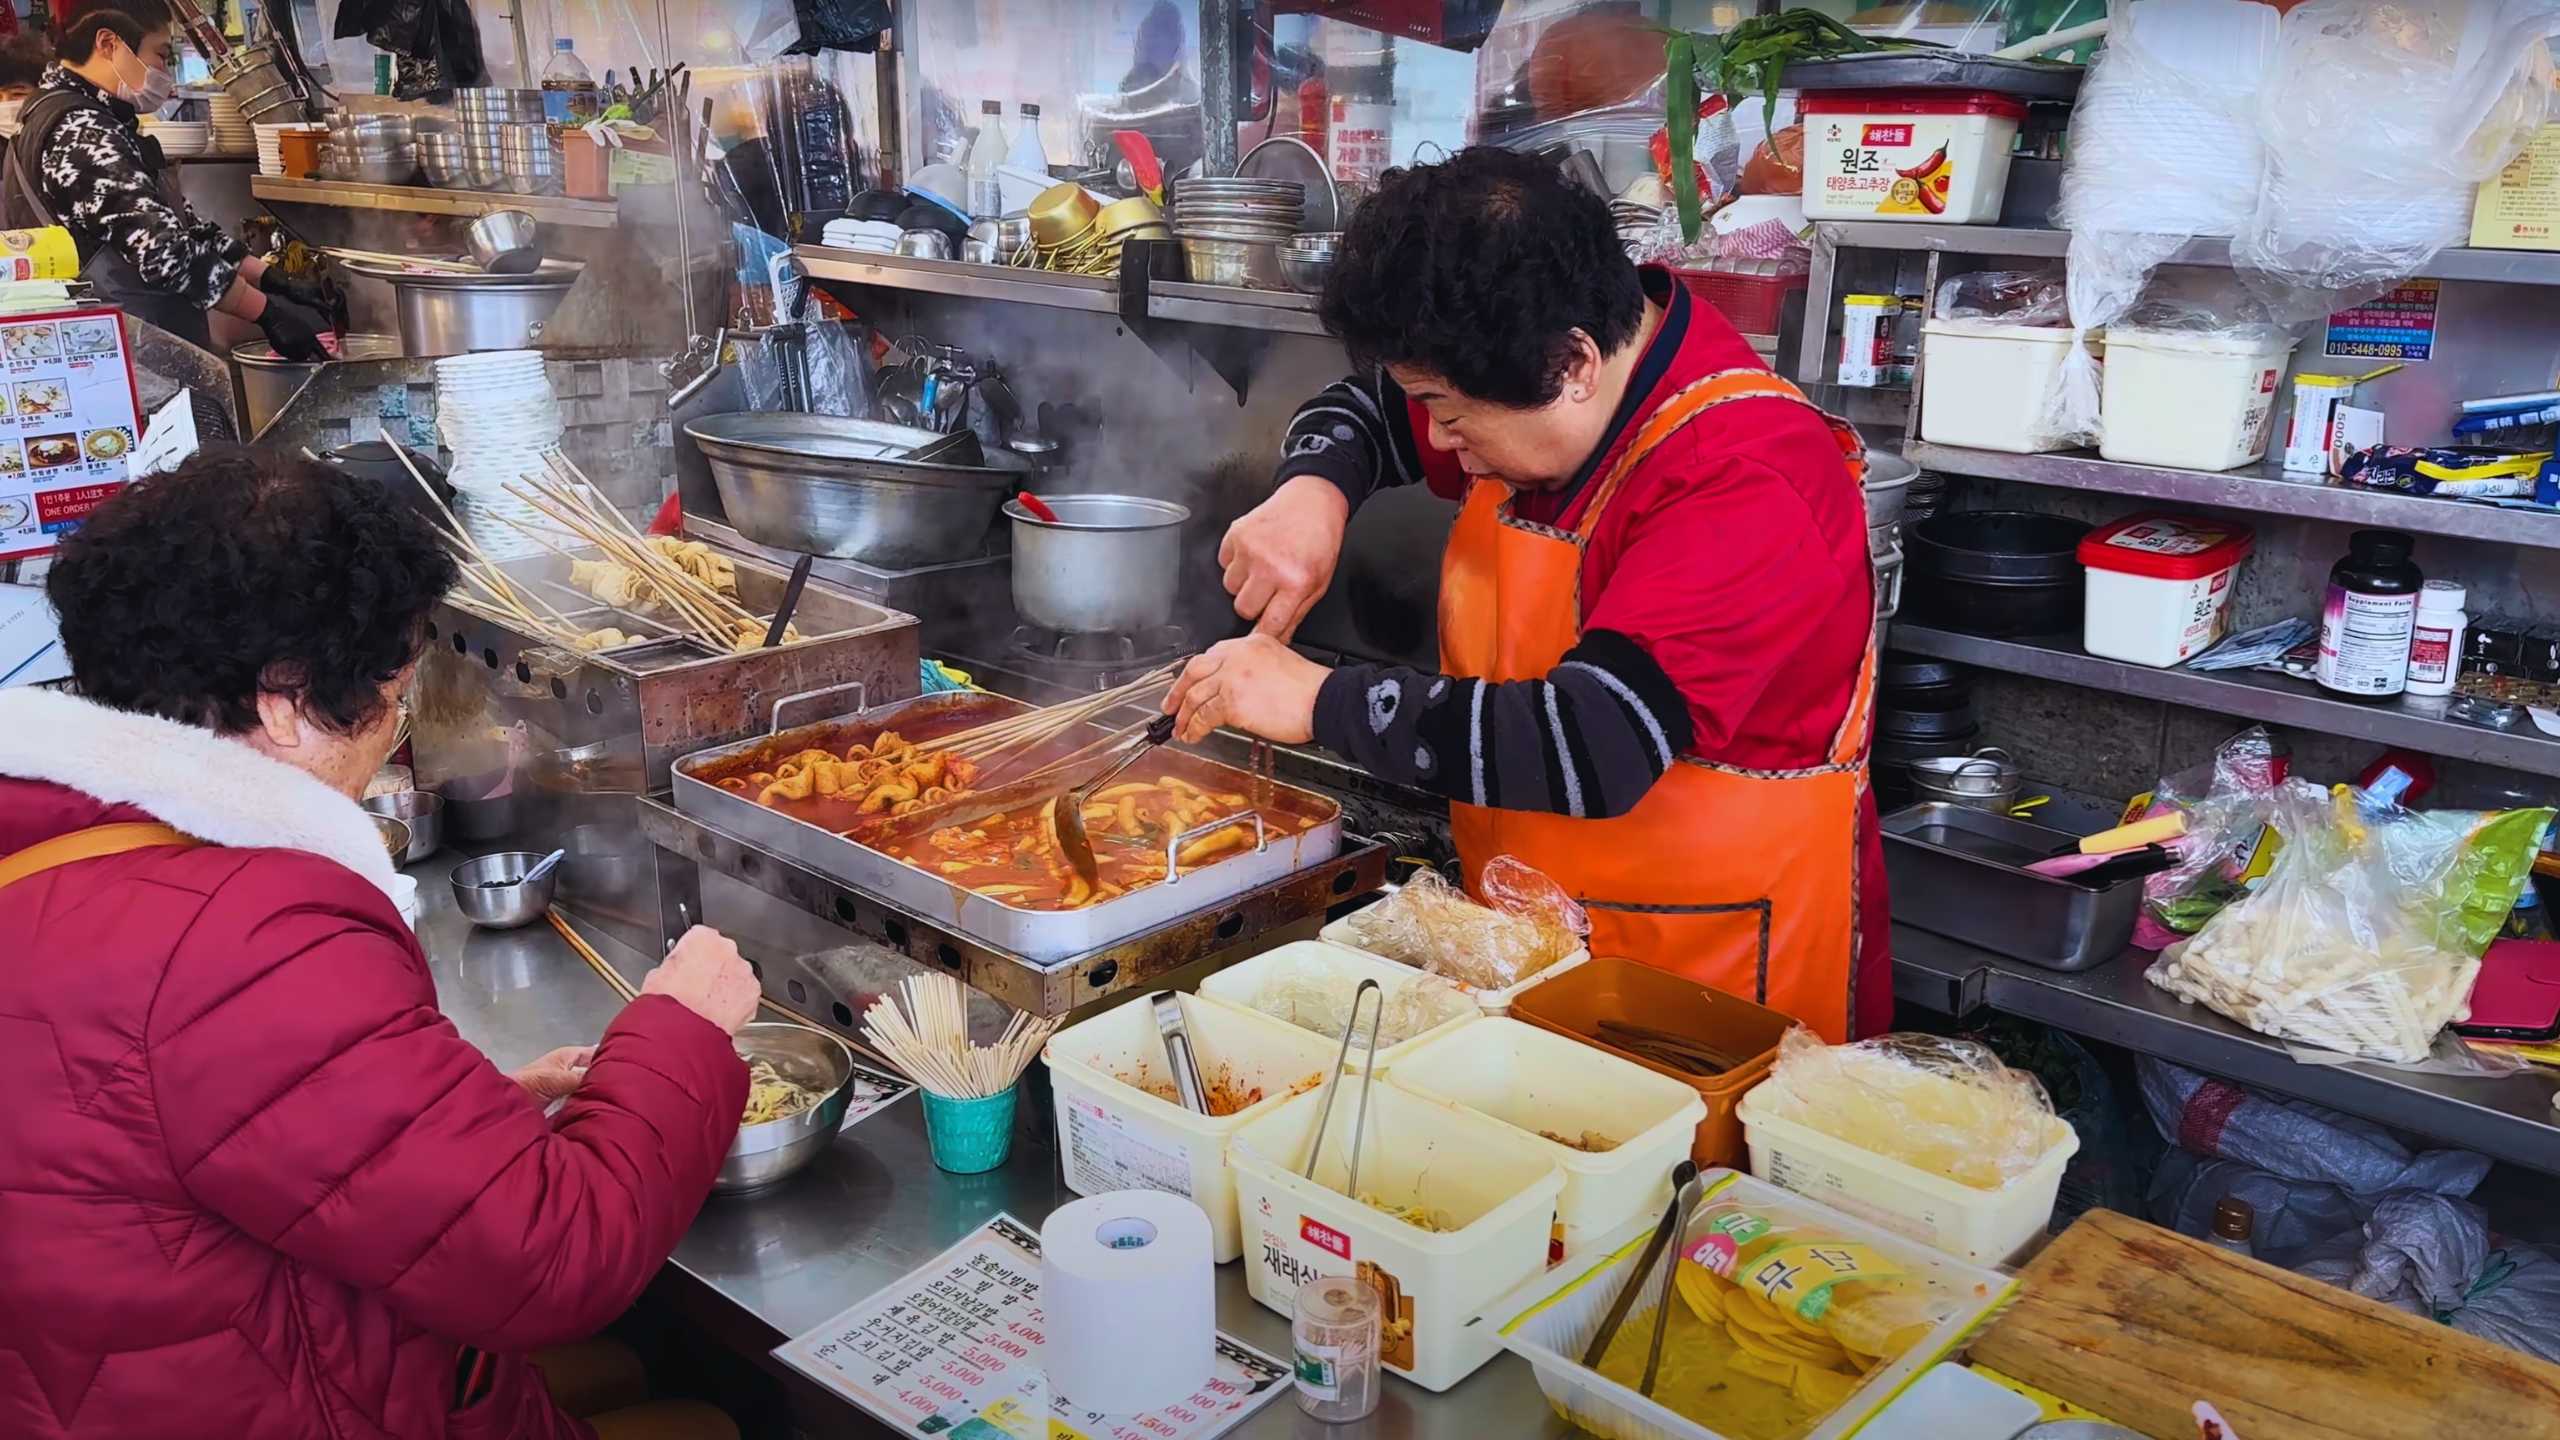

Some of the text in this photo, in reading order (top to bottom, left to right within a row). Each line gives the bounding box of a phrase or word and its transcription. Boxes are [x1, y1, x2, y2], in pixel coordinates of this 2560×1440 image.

[1869, 129, 1905, 143] 해찬들
[1840, 148, 1880, 174] 원조
[1826, 176, 1890, 192] 태양초고추장
[2329, 342, 2402, 357] 010-5448-0995
[44, 503, 90, 517] ONE ORDER
[2348, 596, 2392, 607] Supplement
[1307, 1225, 1345, 1254] 해찬들
[984, 1333, 1028, 1359] 5,000
[962, 1346, 1007, 1373] 5,000
[940, 1360, 985, 1387] 5,000
[918, 1374, 963, 1401] 5,000
[897, 1389, 941, 1415] 4,000
[1131, 1411, 1178, 1437] 1,500
